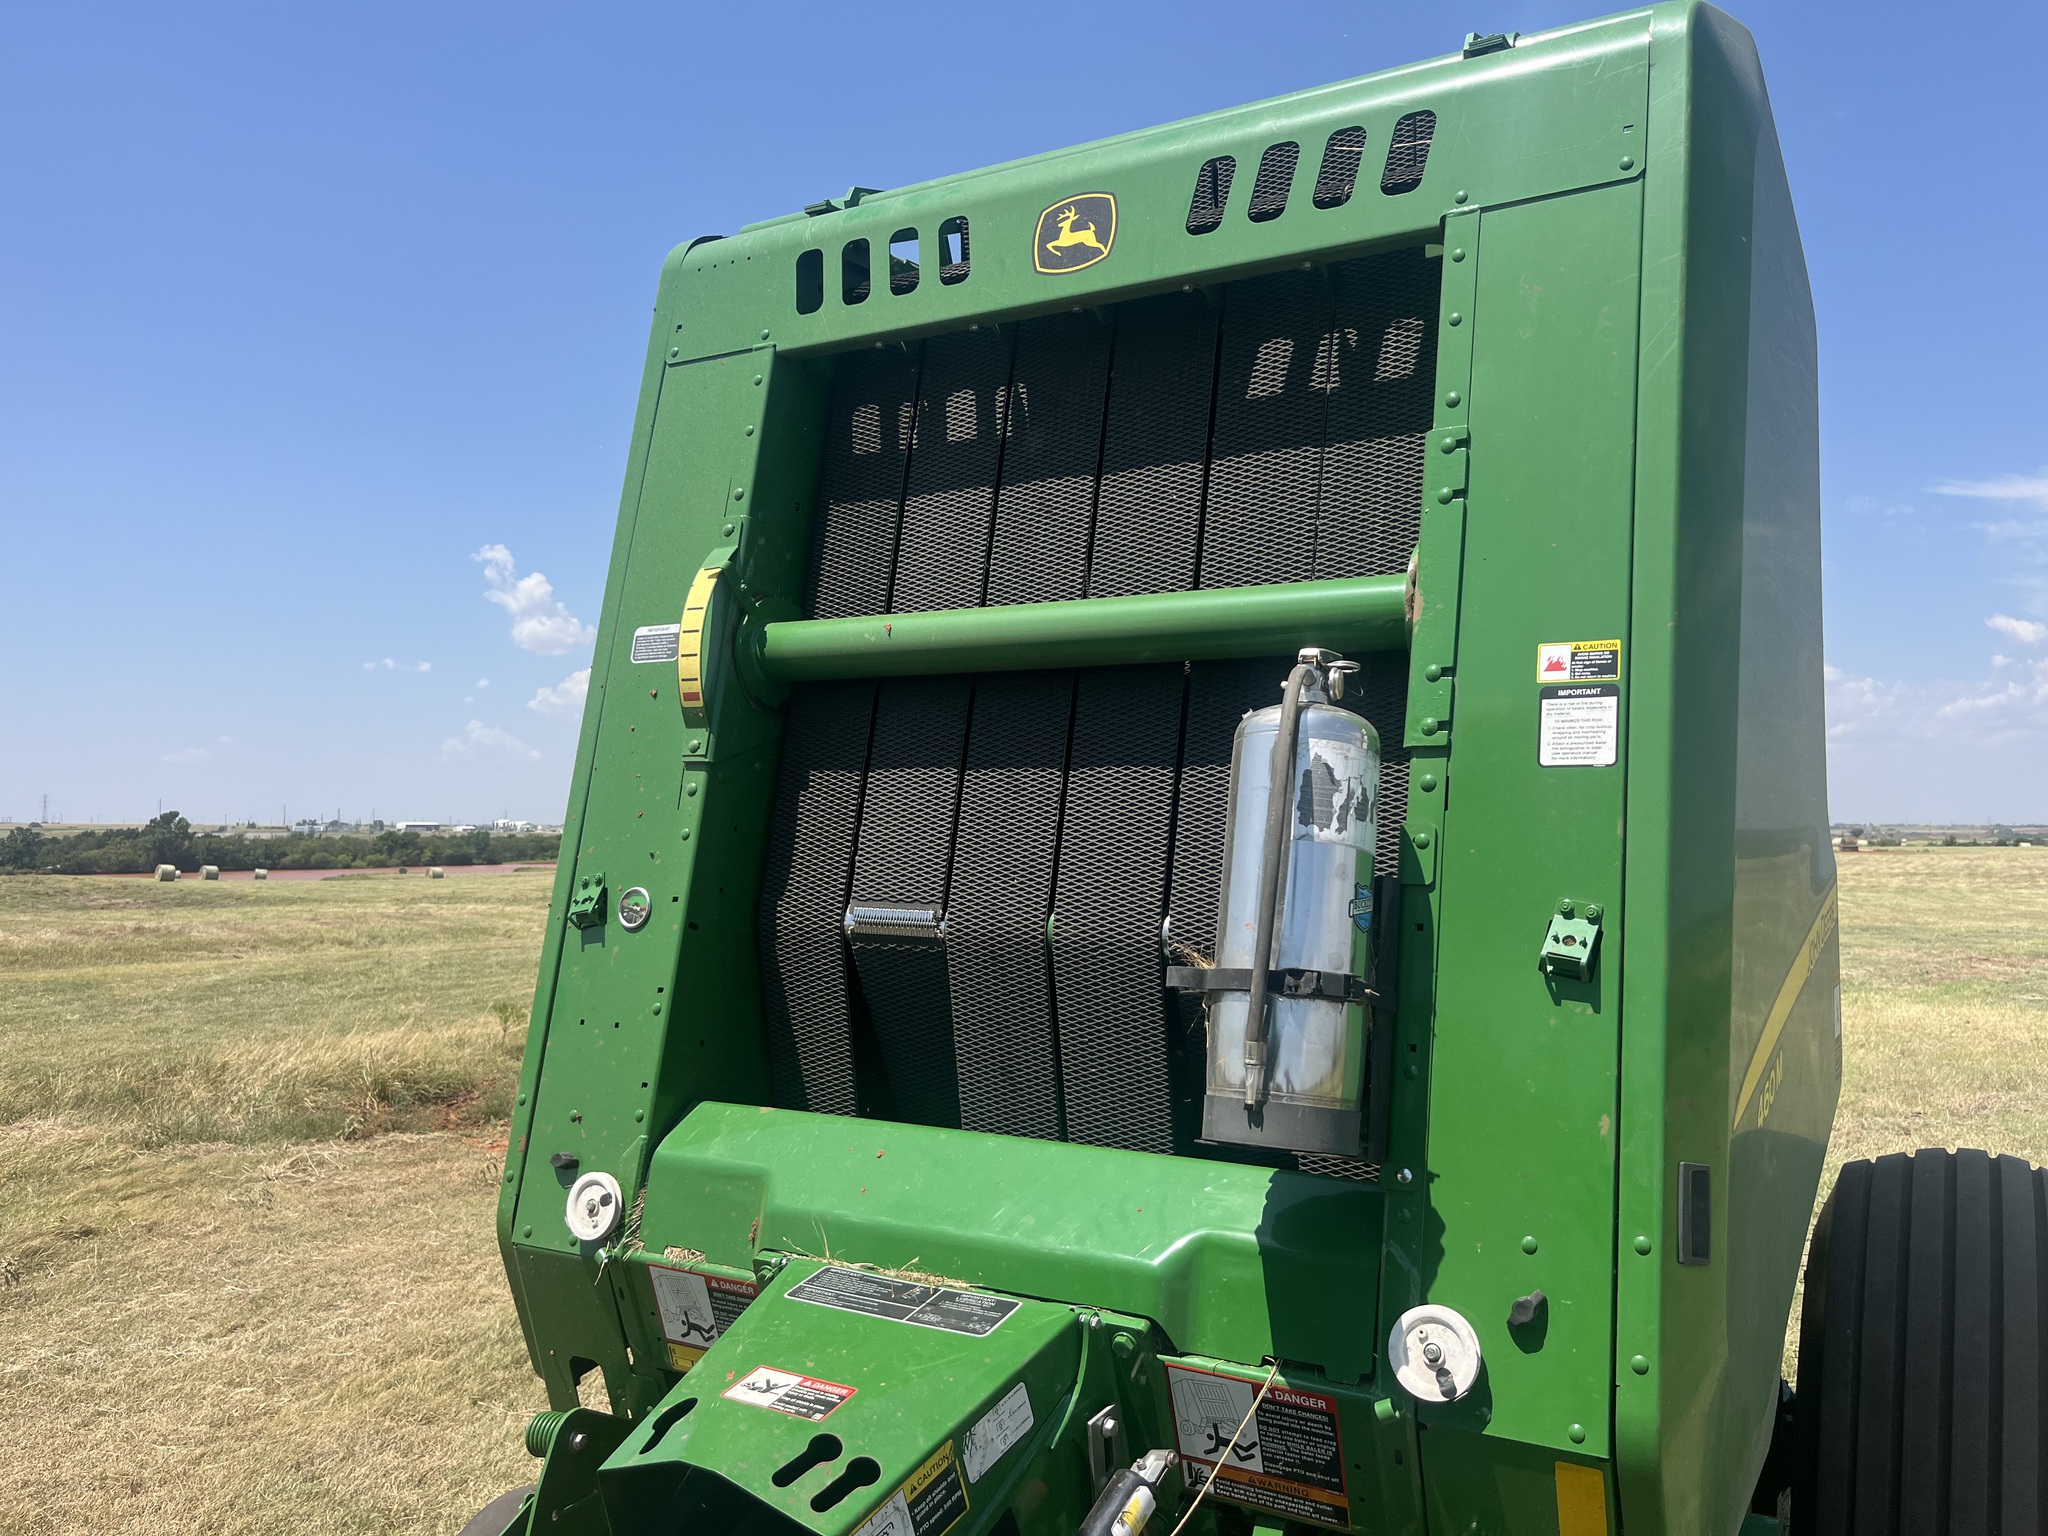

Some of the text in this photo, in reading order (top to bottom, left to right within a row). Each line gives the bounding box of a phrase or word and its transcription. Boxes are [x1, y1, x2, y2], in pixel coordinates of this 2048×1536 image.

[1583, 642, 1617, 650] CAUTION
[719, 1281, 754, 1294] DANGER
[812, 1380, 849, 1395] DANGER
[1275, 1391, 1326, 1409] DANGER
[1262, 1403, 1329, 1422] DON'T TAKE CHANCES!
[1273, 1419, 1289, 1427] pulled
[1311, 1428, 1335, 1437] machine:
[1281, 1416, 1298, 1424] injury
[1307, 1421, 1323, 1429] death
[1281, 1430, 1302, 1439] attempt
[1261, 1440, 1287, 1451] RUNNING.
[1315, 1453, 1330, 1461] feeds
[1261, 1446, 1284, 1455] material
[1285, 1451, 1300, 1459] faster
[1286, 1441, 1304, 1449] WHILE
[1306, 1445, 1325, 1455] BALER
[1316, 1443, 1335, 1452] unplug
[1263, 1460, 1292, 1473] Disengage
[1293, 1467, 1304, 1475] PTO
[1274, 1454, 1294, 1463] release
[917, 1453, 949, 1486] CAUTION
[914, 1500, 926, 1514] Keep
[932, 1480, 947, 1496] shields
[947, 1471, 955, 1483] and
[1257, 1478, 1309, 1497] WARNING
[915, 1507, 929, 1521] guard
[934, 1490, 947, 1504] place.
[1216, 1483, 1232, 1491] Twine
[1275, 1498, 1314, 1513] unexpectedly.
[1231, 1482, 1254, 1492] crushing
[1255, 1488, 1277, 1497] between
[1316, 1504, 1334, 1512] cutter.
[919, 1521, 929, 1534] PTO
[930, 1507, 943, 1524] speed:
[952, 1489, 962, 1502] RPM
[1231, 1492, 1247, 1500] hands
[1274, 1503, 1286, 1511] path
[1320, 1516, 1340, 1525] power.
